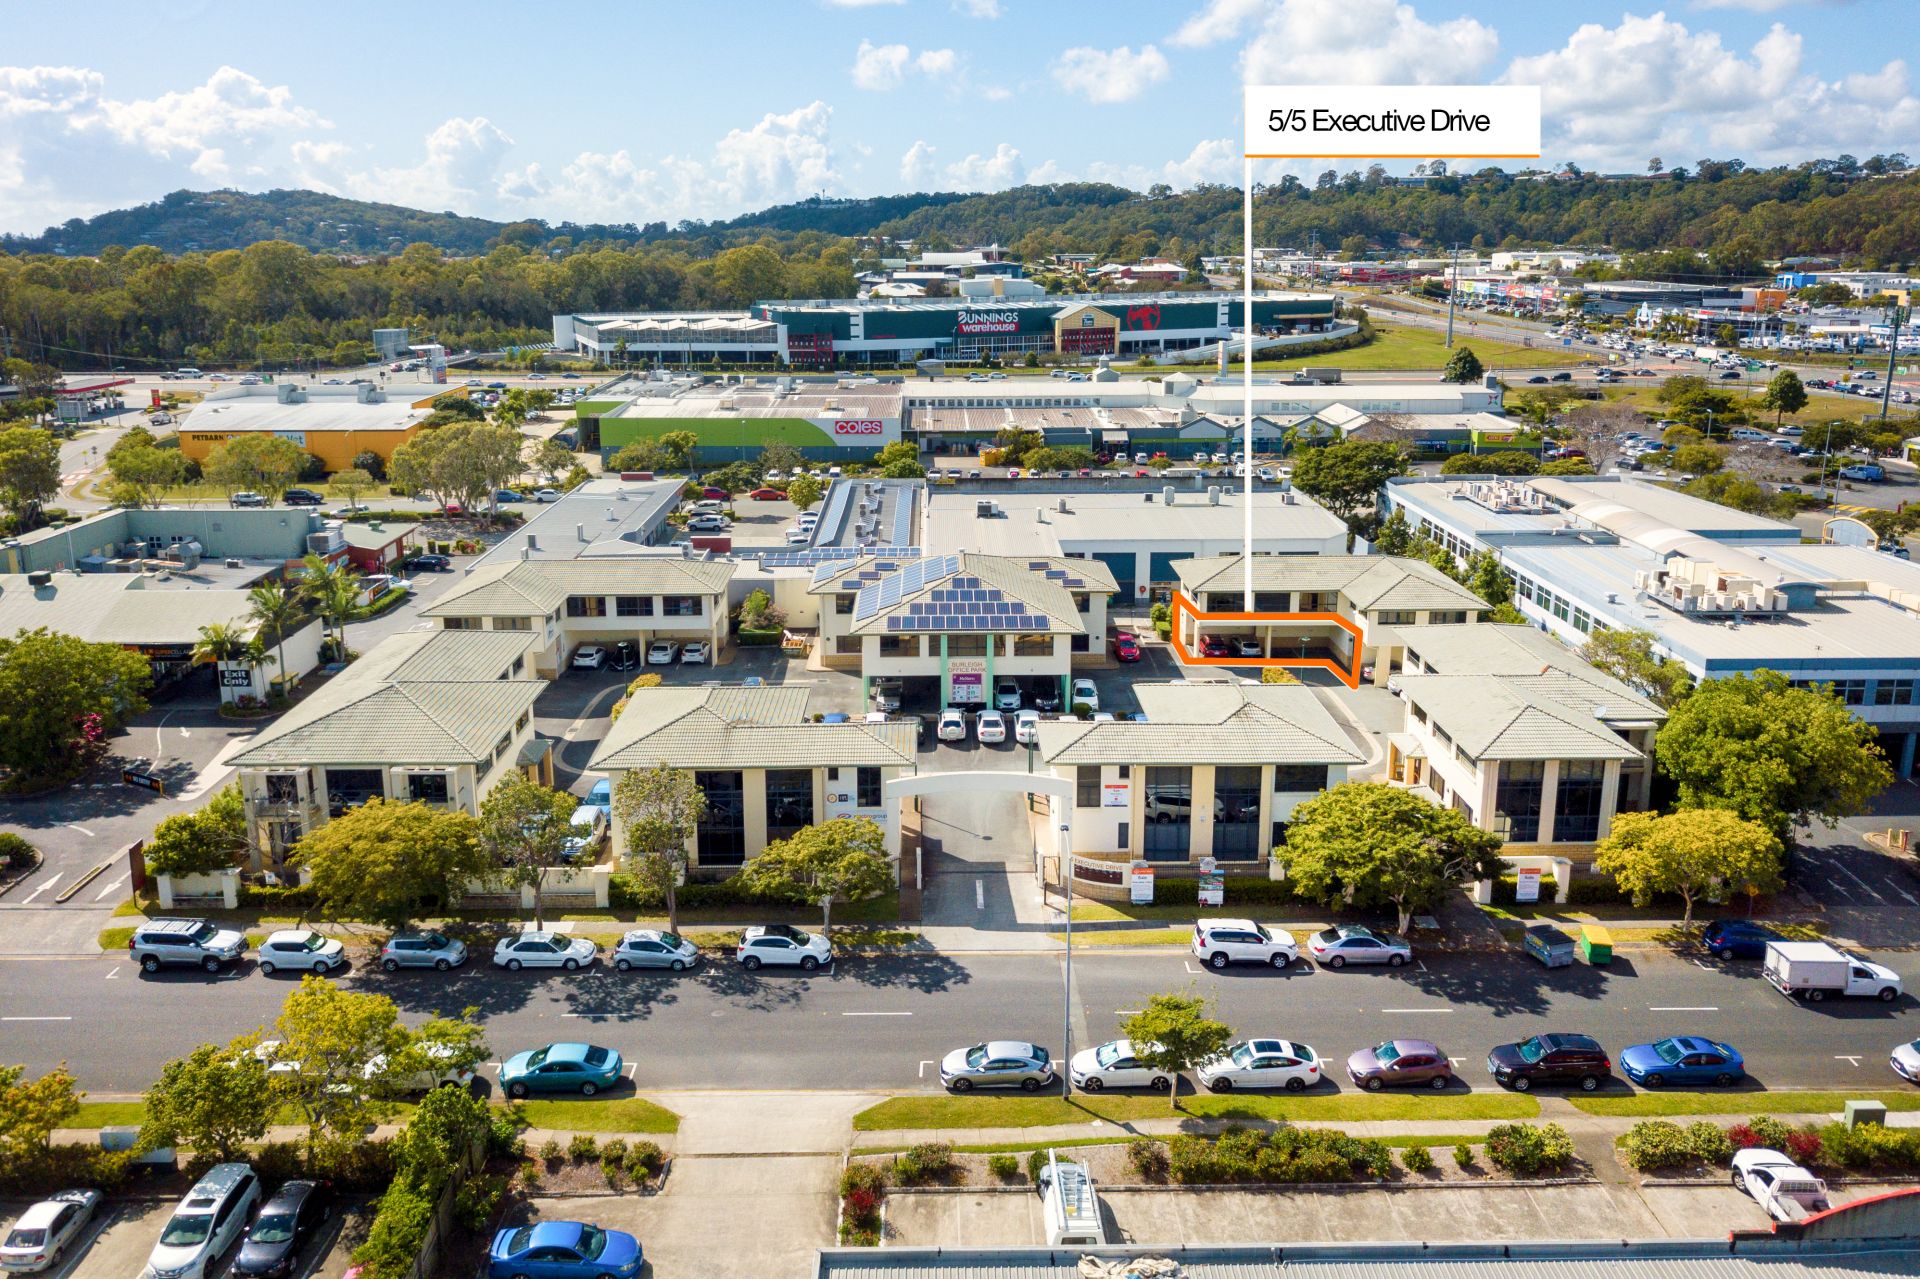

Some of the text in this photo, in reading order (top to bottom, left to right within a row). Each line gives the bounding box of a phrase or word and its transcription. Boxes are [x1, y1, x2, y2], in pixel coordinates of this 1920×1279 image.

[957, 311, 1019, 324] BUNNINGS
[962, 321, 1016, 332] warehouse
[836, 421, 881, 433] coles
[224, 678, 249, 686] Only
[1075, 858, 1104, 868] EXECUTIVE
